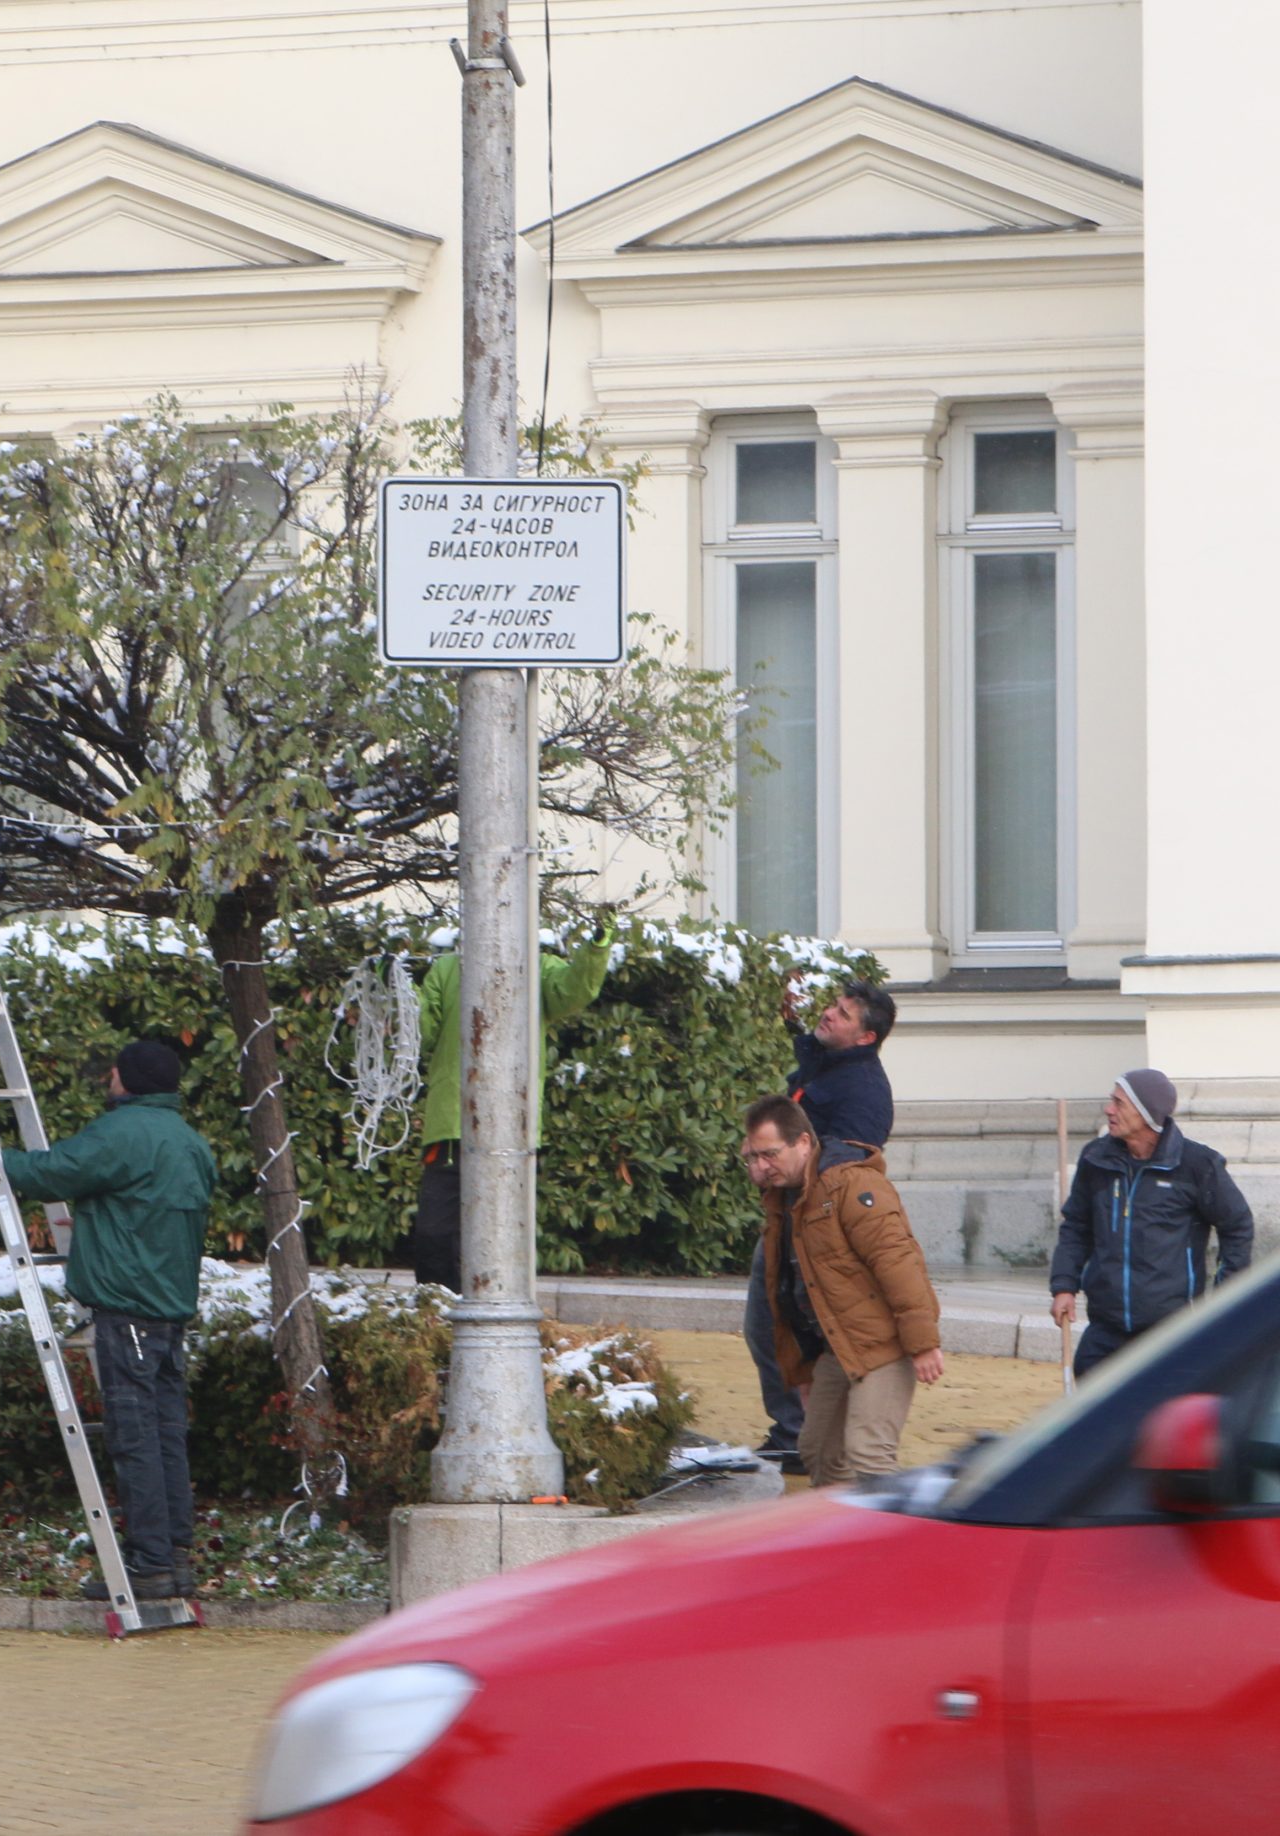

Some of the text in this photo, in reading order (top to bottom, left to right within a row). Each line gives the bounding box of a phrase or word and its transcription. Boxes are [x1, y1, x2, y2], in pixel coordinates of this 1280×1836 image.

[399, 494, 605, 513] ЗОНА ЗА СИГУРНОСТ
[451, 518, 554, 535] 24-ЧАСОВ
[428, 541, 579, 560] ВИДЕОКОНТРОЛ
[422, 584, 580, 602] SECURITY ZONE
[450, 609, 553, 626] 24-HOURS
[429, 632, 576, 650] VIDEO CONTROL
